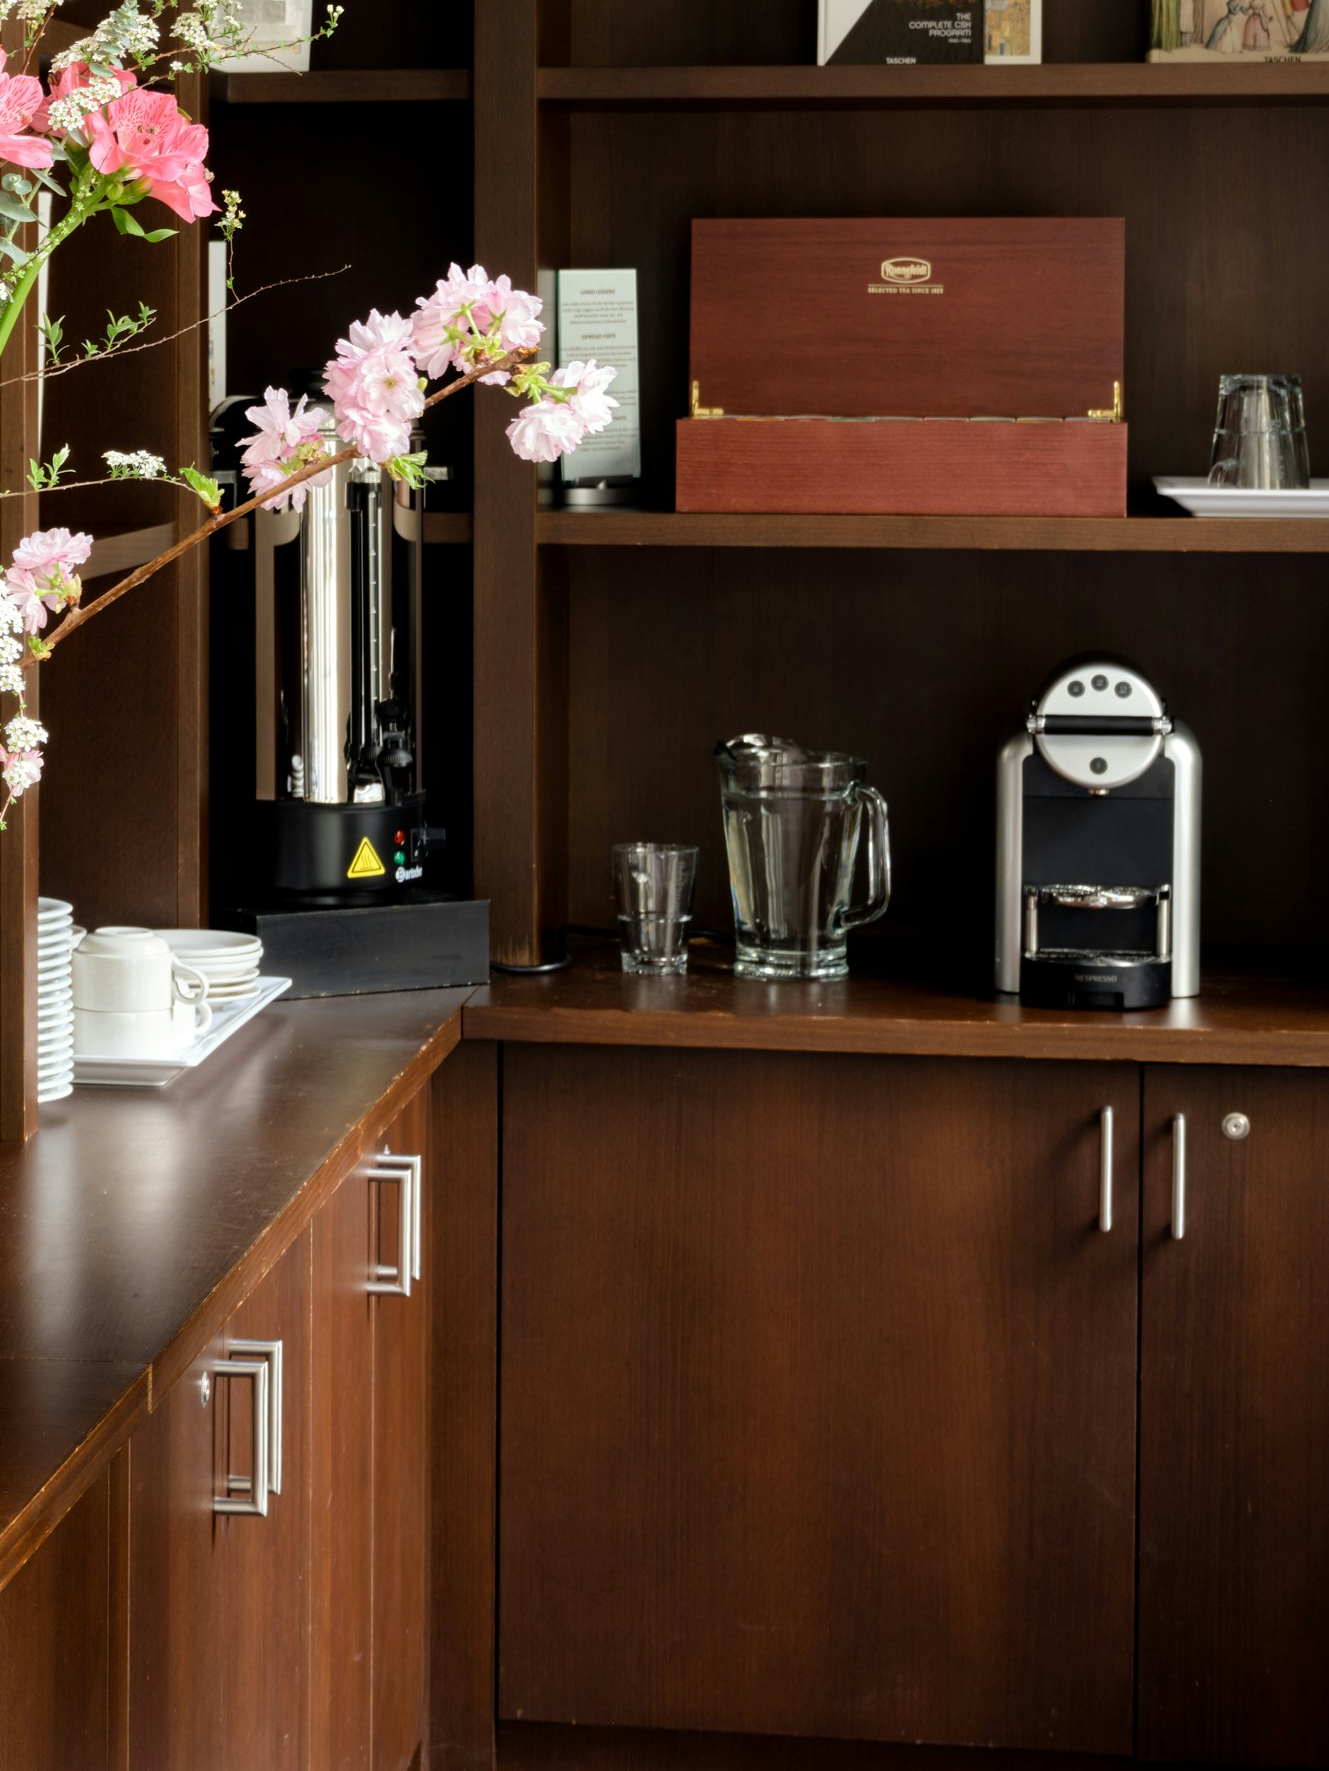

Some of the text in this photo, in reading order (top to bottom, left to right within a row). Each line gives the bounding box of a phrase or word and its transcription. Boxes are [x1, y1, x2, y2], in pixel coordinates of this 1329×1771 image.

[956, 12, 972, 20] THE
[908, 20, 952, 29] COMPLETE
[929, 29, 972, 37] PROGRAM
